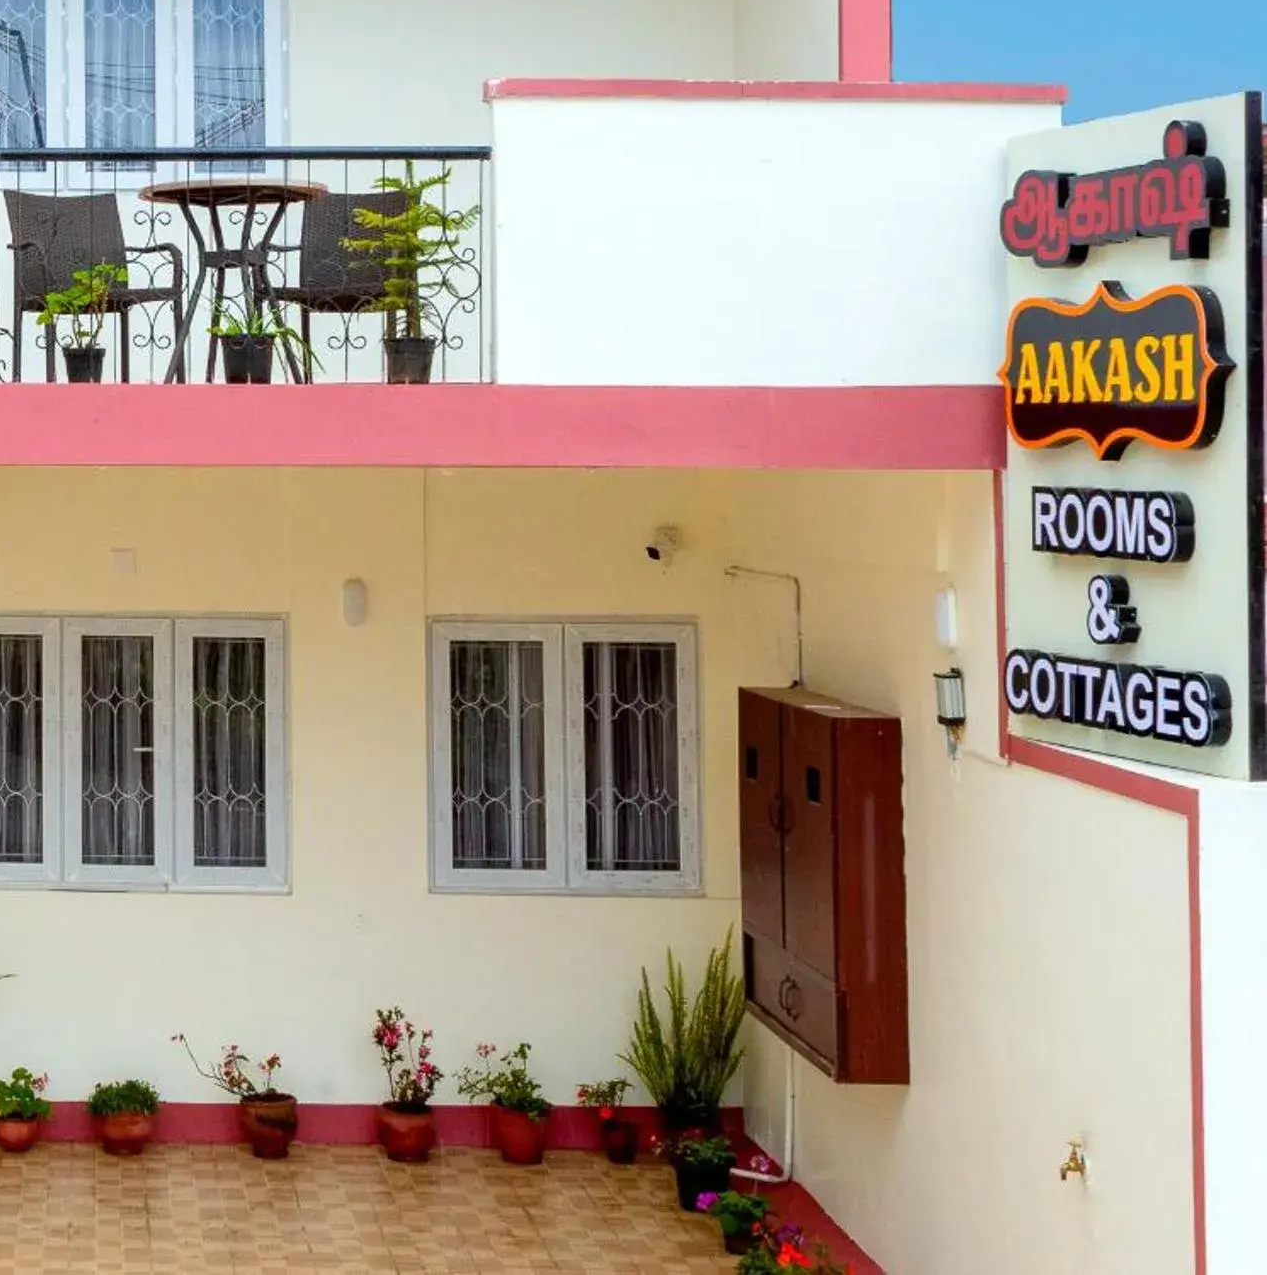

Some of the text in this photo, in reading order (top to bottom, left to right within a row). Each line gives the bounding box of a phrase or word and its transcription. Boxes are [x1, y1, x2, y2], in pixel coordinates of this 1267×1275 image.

[1003, 125, 1207, 262] ஆகாஷ்
[1014, 332, 1196, 405] AAKASH
[1033, 491, 1174, 557] ROOMS
[1087, 577, 1121, 642] &
[1005, 653, 1210, 742] COTTAGES
